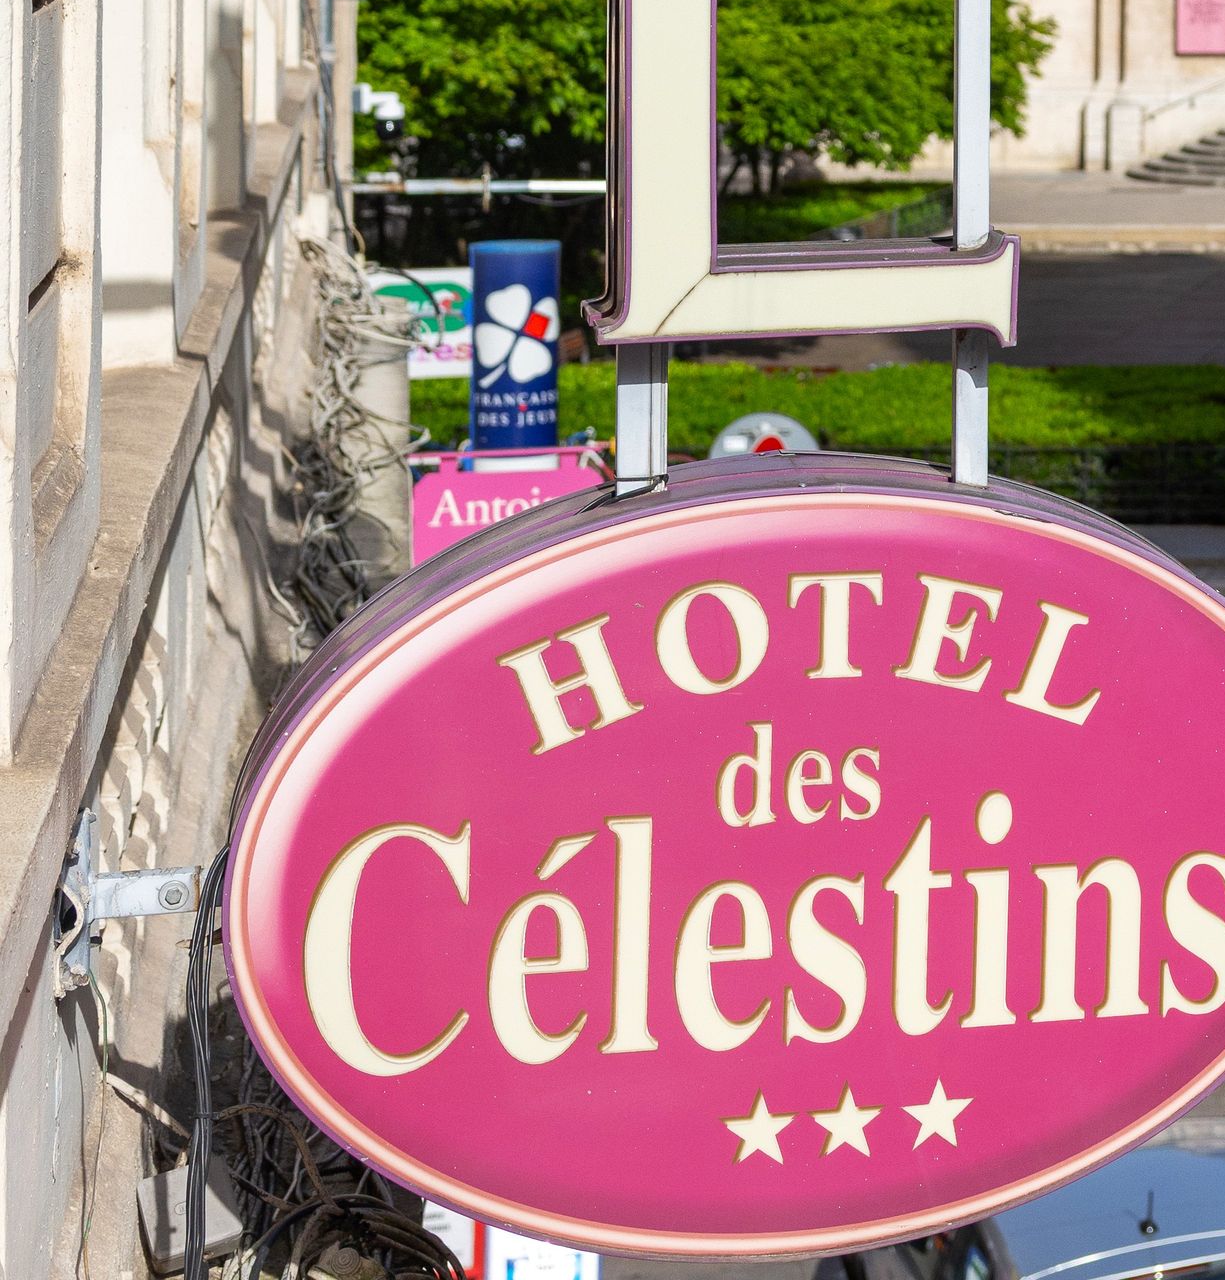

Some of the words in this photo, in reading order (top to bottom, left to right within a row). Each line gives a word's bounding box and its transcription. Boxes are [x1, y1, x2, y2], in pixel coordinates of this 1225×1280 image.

[478, 411, 511, 428] DES
[497, 571, 1103, 756] HOTEL
[716, 721, 883, 828] des
